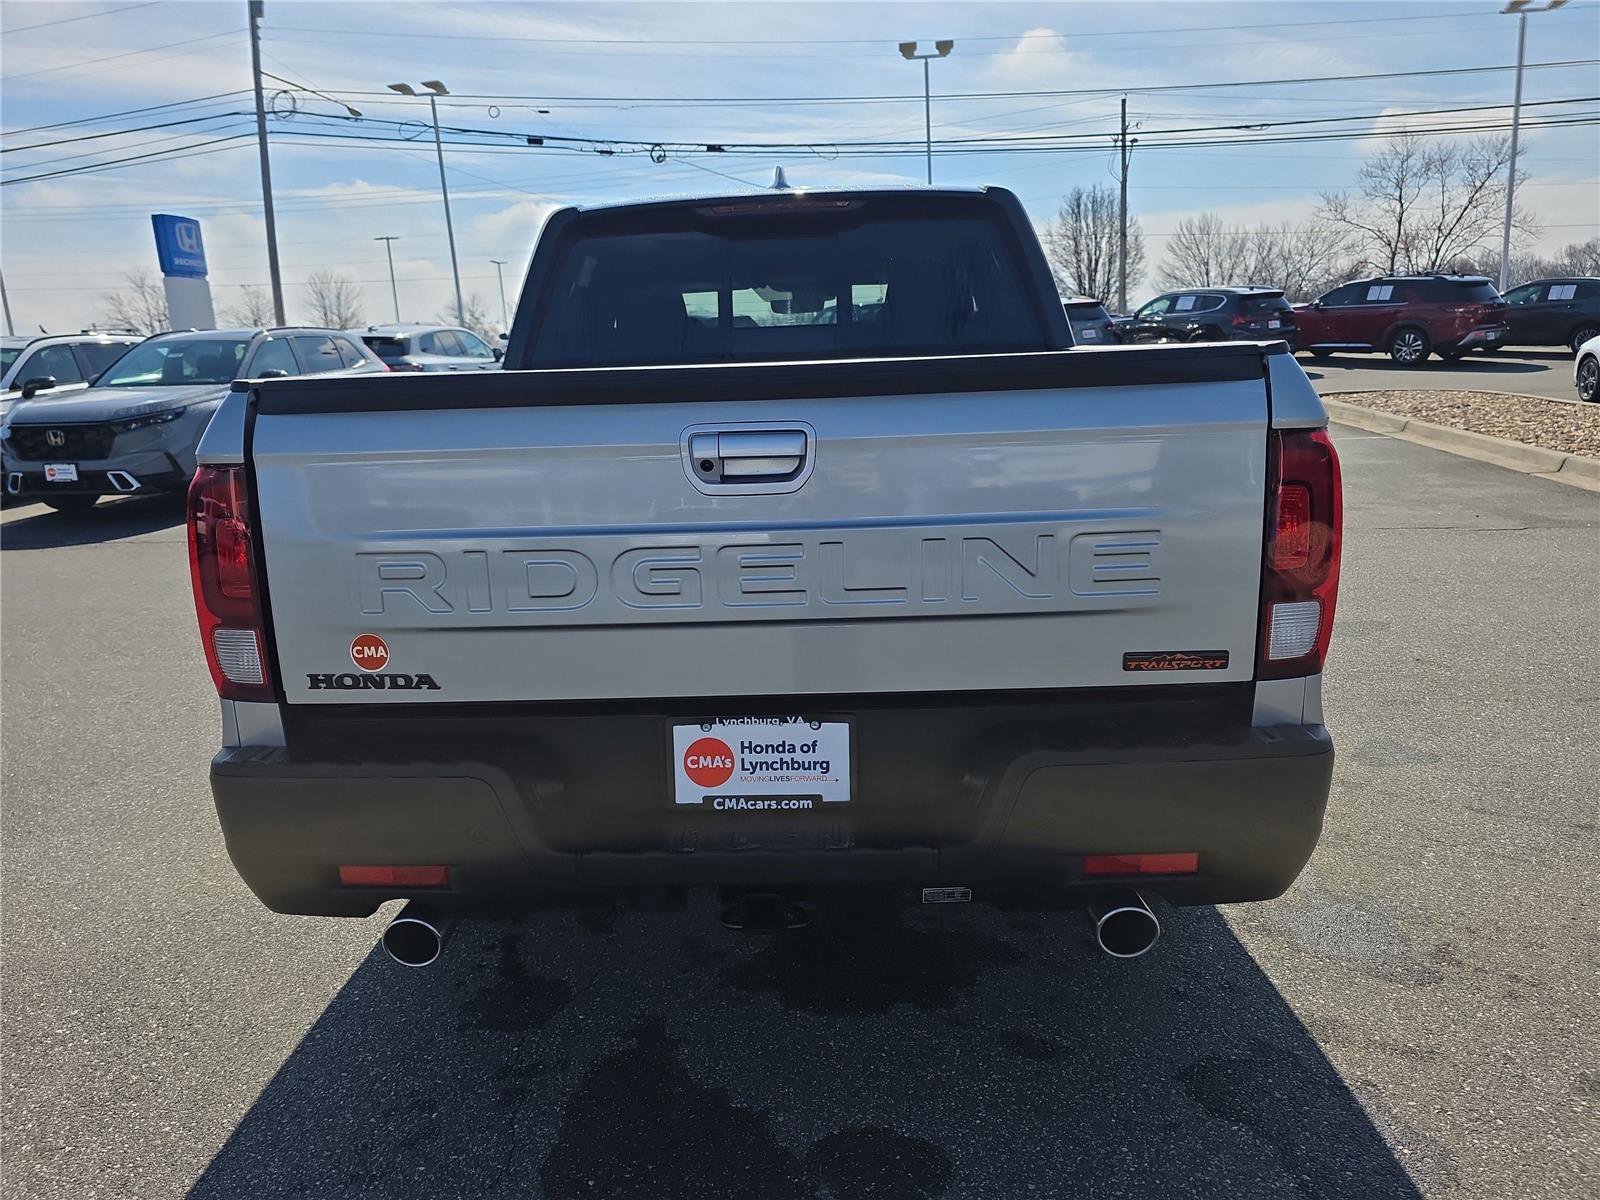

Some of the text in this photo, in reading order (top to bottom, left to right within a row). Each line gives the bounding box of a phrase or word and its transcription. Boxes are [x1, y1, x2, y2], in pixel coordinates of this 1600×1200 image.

[355, 530, 1162, 614] RIDGELINE
[352, 646, 388, 659] CMA
[1127, 659, 1227, 670] TRAILSPORT
[306, 673, 442, 690] HONDA
[715, 716, 805, 727] Lynchburg, VA
[740, 740, 818, 755] Honda of
[686, 754, 732, 769] CMA's
[740, 757, 830, 774] Lynchburg
[713, 798, 813, 810] CMAcars.com
